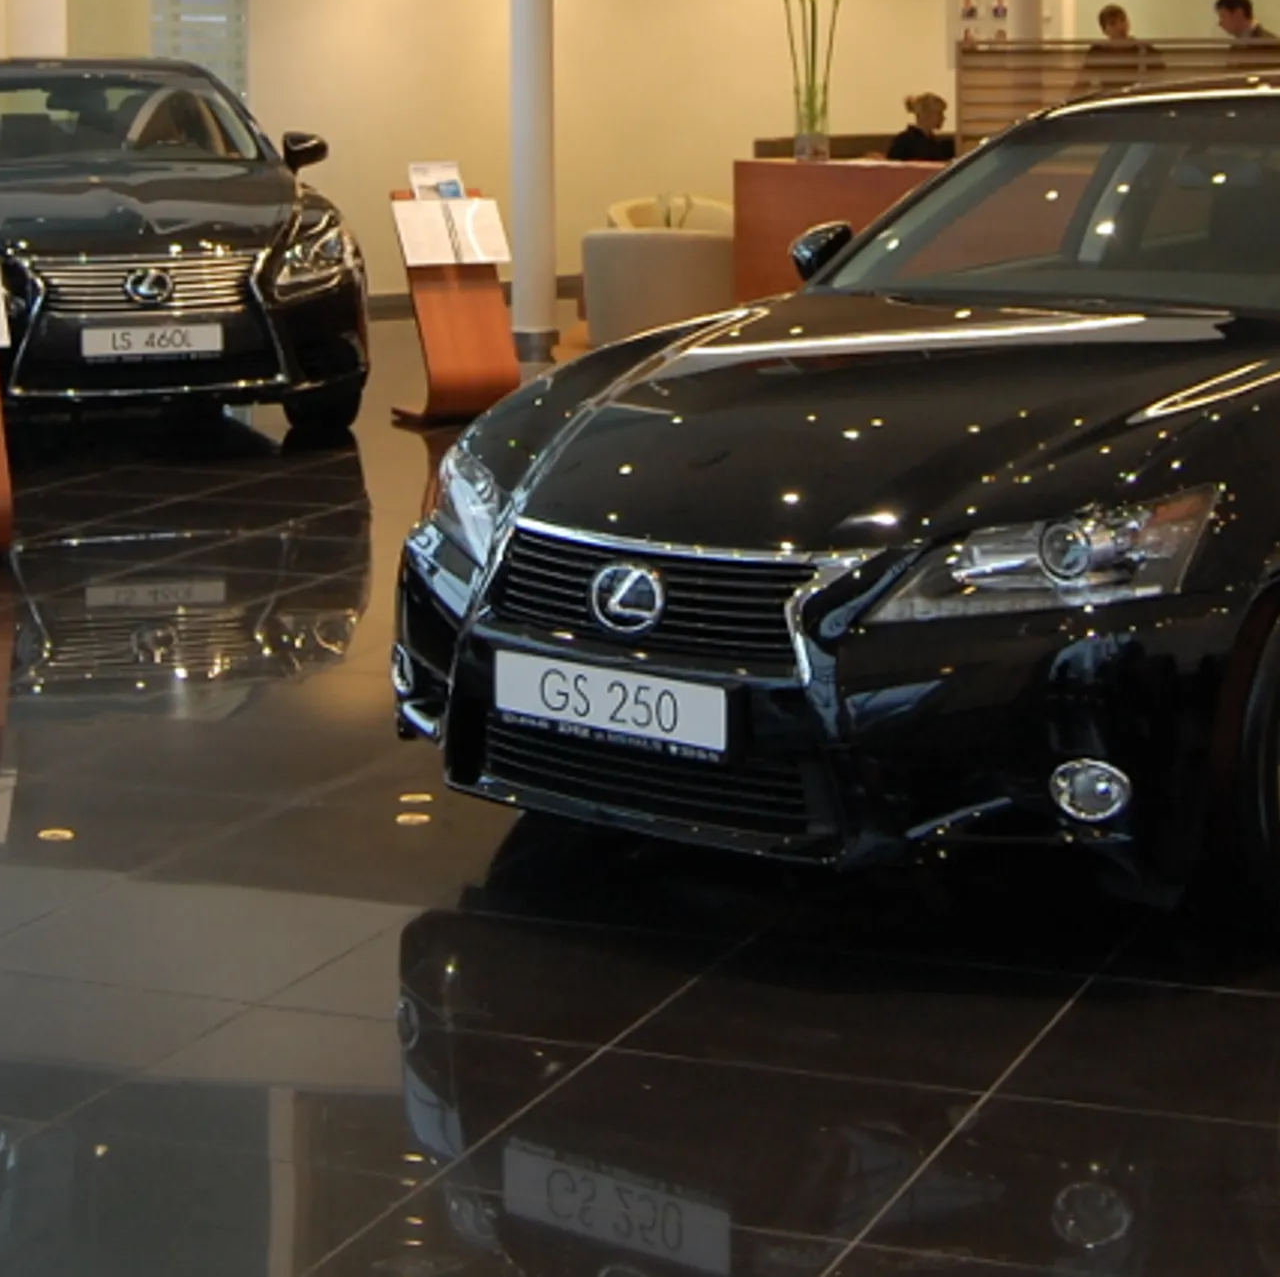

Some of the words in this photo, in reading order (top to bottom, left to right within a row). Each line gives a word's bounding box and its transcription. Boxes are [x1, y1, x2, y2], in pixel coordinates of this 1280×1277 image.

[111, 331, 132, 351] LS
[144, 328, 194, 349] 460L
[539, 667, 591, 718] GS
[606, 680, 679, 734] 250
